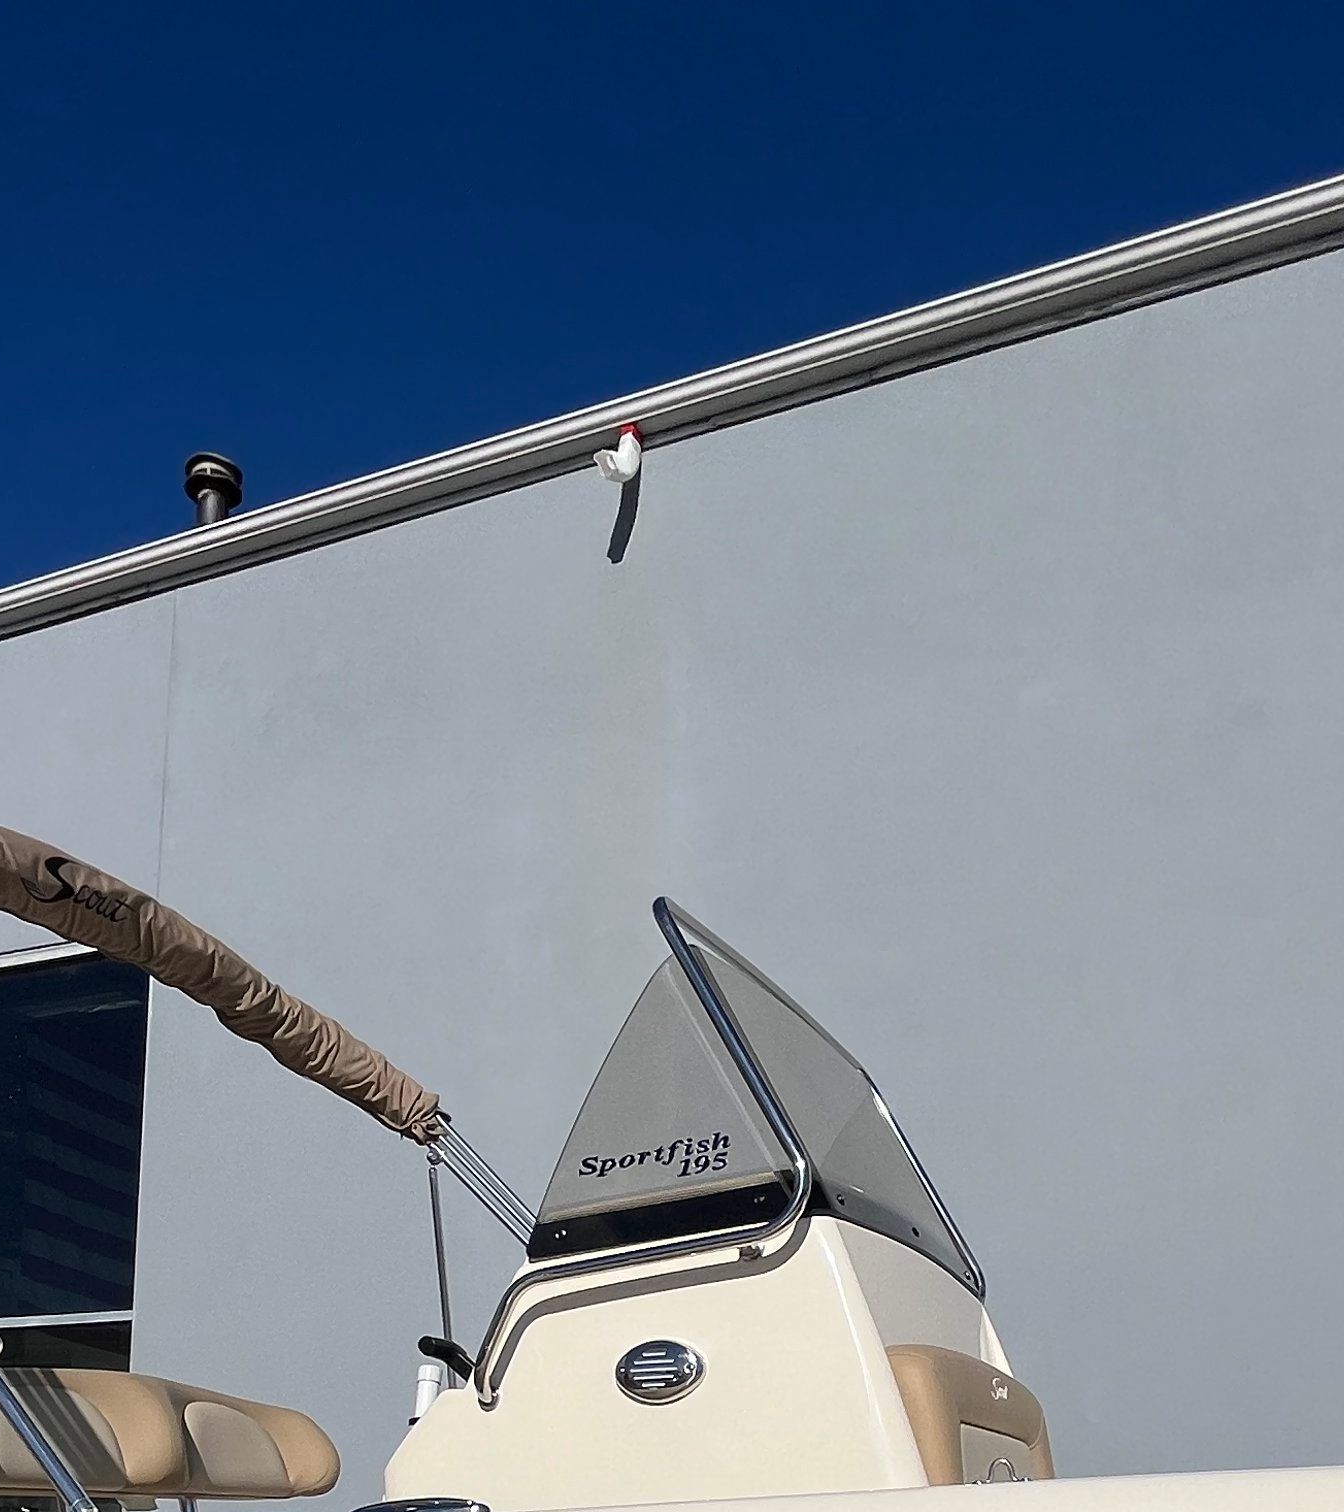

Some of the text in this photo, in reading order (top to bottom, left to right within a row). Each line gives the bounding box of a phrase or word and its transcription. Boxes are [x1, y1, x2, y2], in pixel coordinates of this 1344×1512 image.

[20, 856, 136, 922] Scout
[578, 1132, 730, 1177] Sportfish
[677, 1151, 728, 1177] 195
